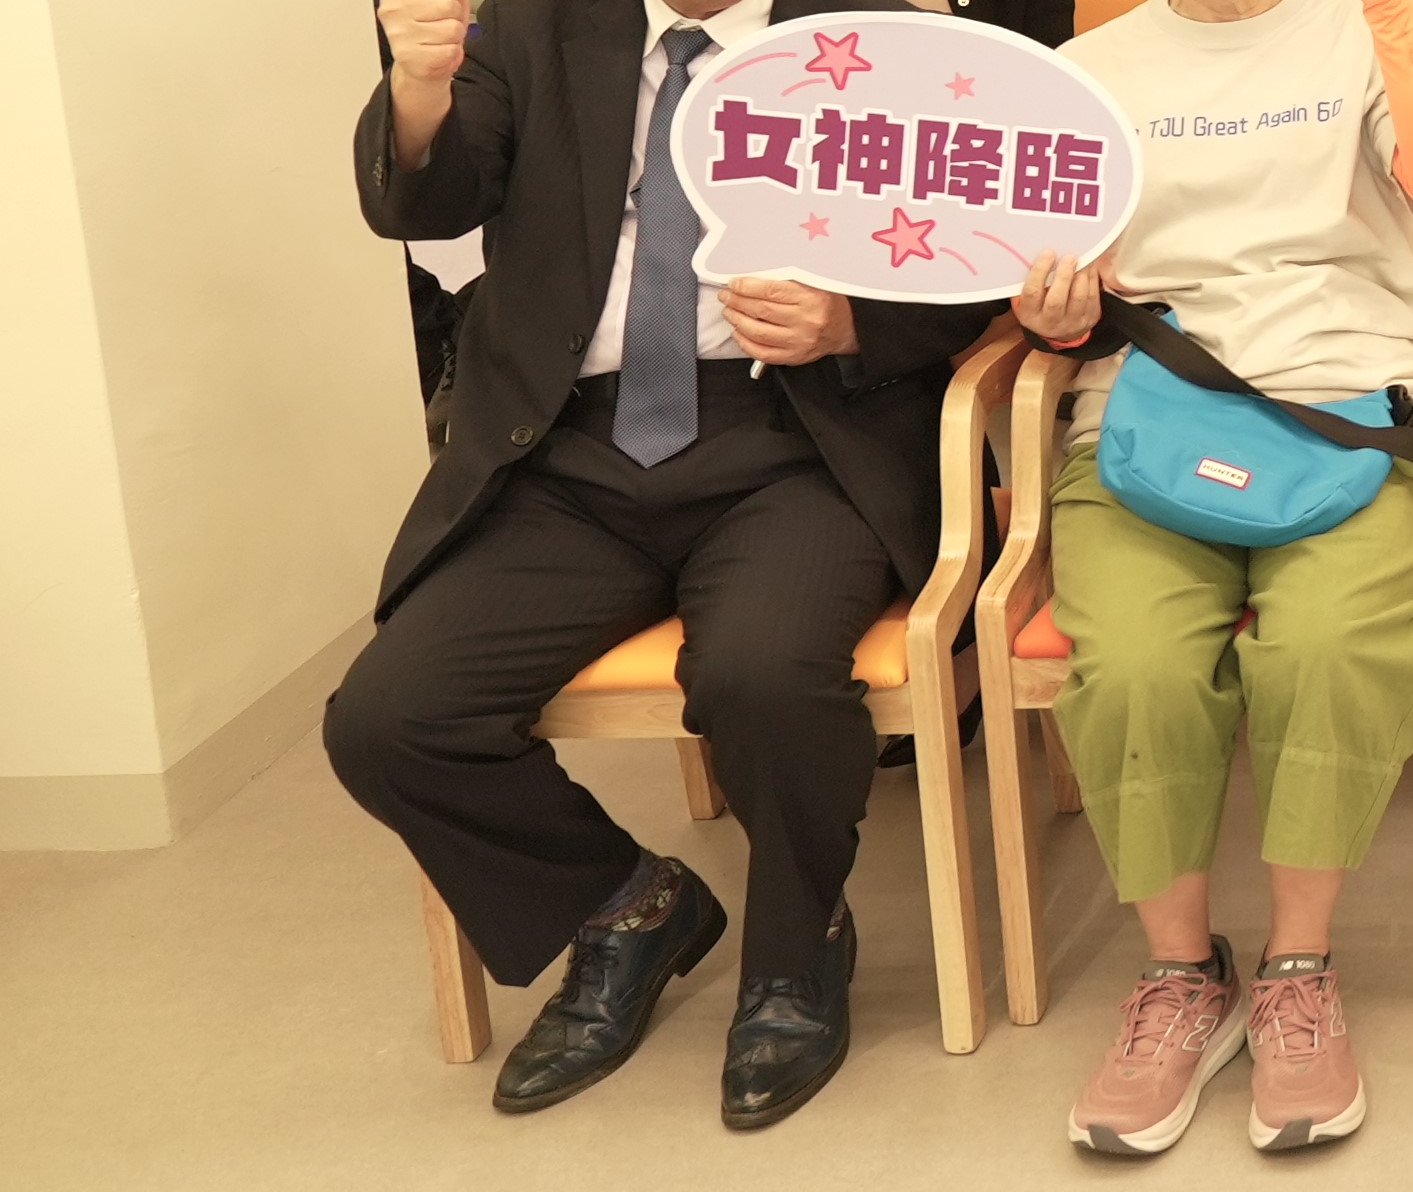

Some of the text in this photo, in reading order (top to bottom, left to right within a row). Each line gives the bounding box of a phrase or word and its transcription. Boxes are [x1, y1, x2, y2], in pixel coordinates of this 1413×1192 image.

[1149, 116, 1185, 139] TJU
[1193, 116, 1248, 137] Great
[1256, 104, 1308, 130] Again
[710, 99, 1104, 217] 女神降臨
[1202, 464, 1244, 481] HUNTER
